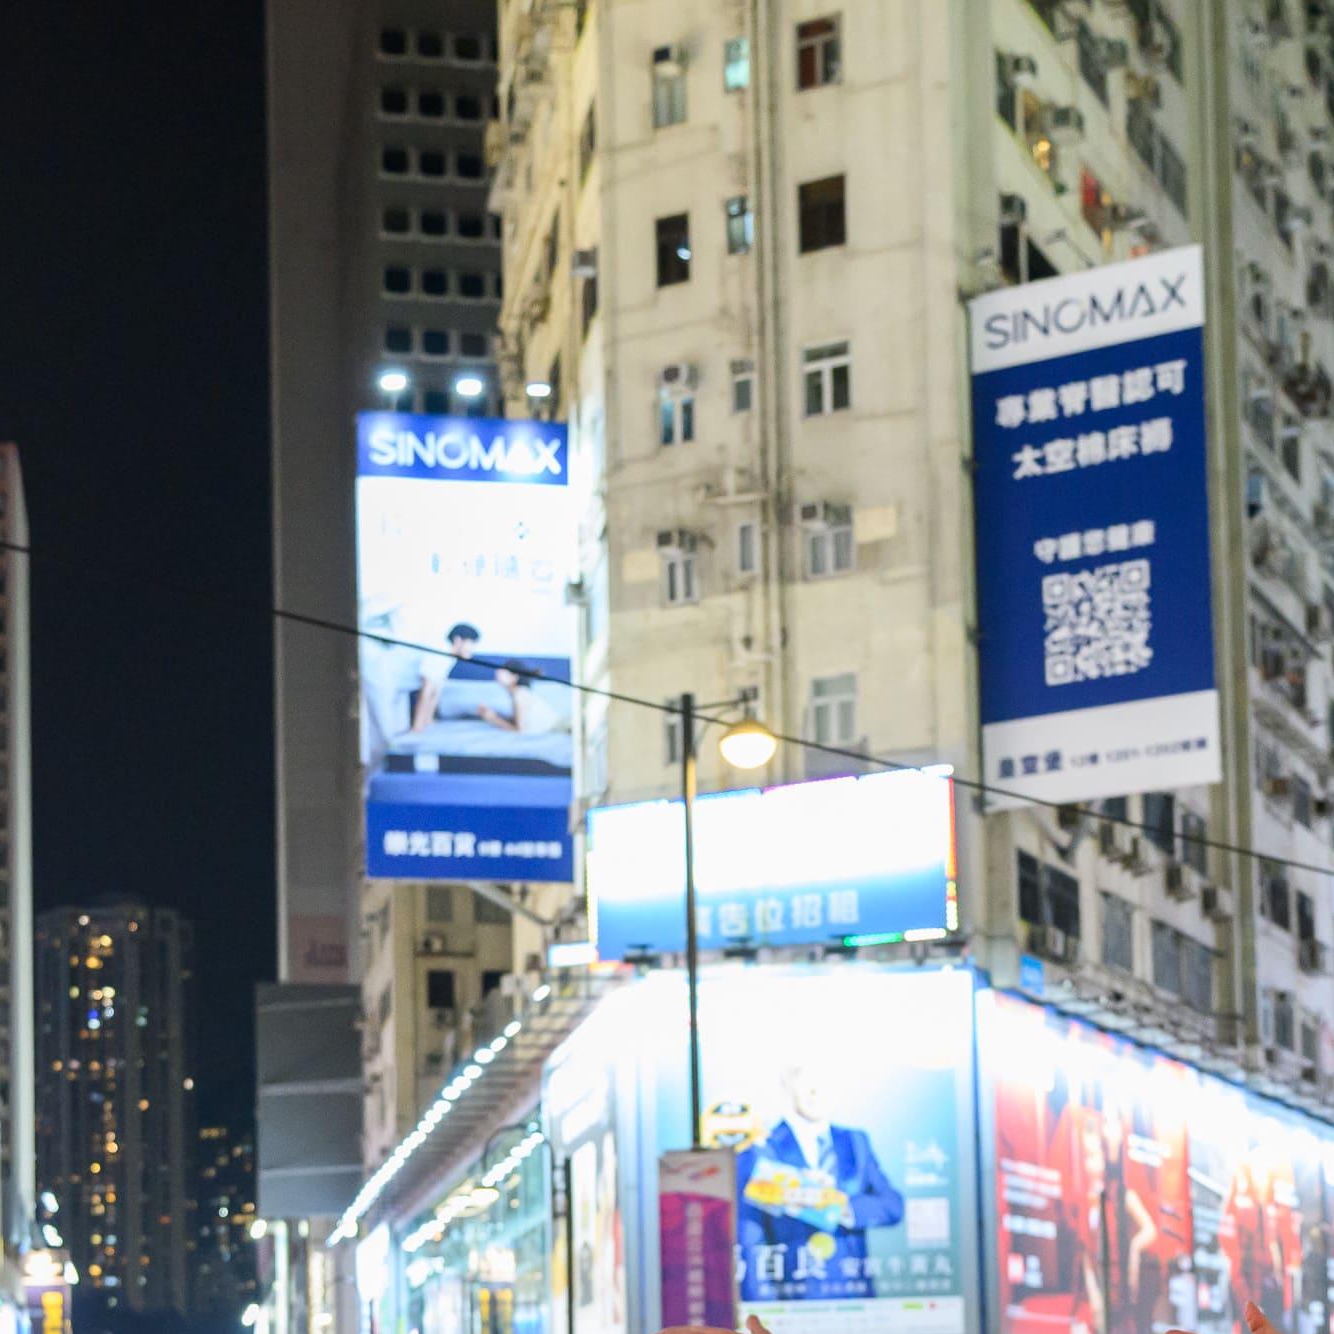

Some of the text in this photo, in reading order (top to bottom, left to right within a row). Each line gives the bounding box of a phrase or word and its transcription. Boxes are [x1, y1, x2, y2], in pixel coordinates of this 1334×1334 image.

[984, 273, 1186, 349] SINOMAX
[368, 431, 563, 475] SINOMAX
[734, 1243, 828, 1282] 百良
